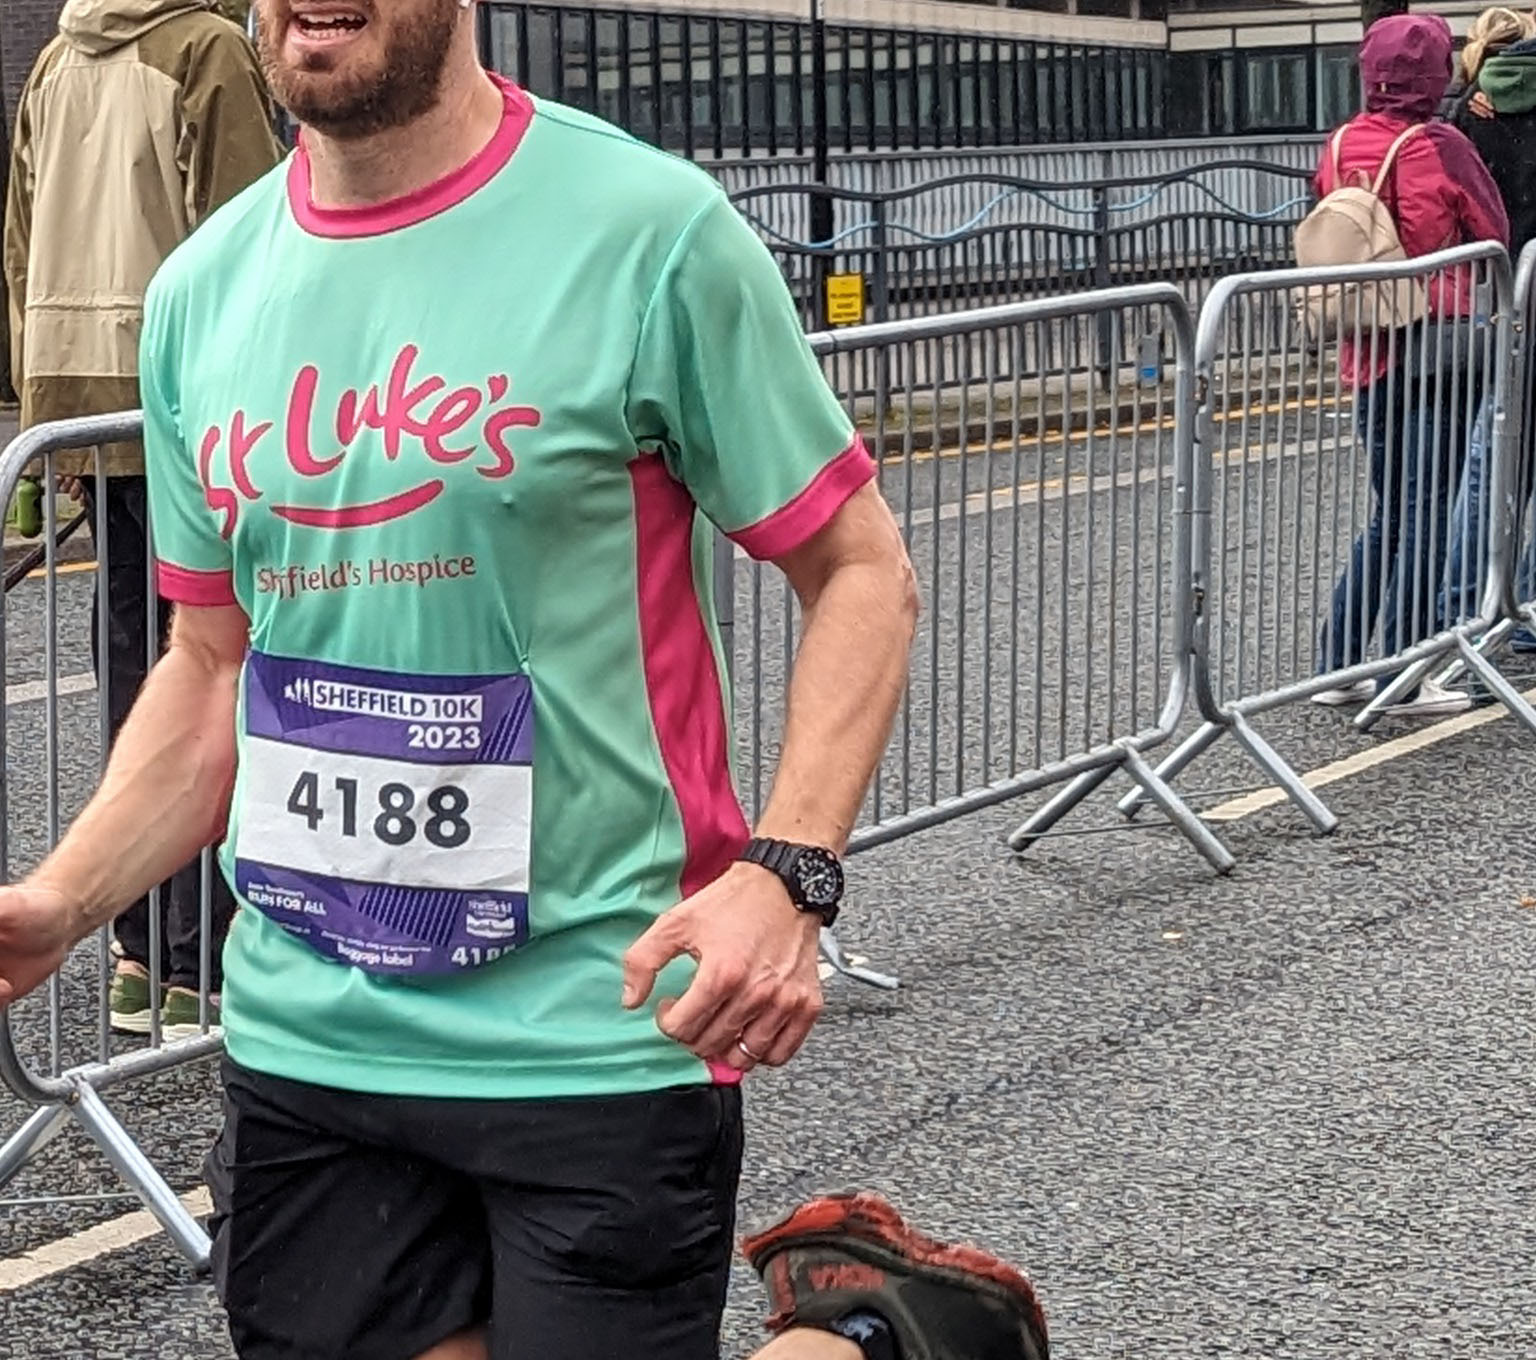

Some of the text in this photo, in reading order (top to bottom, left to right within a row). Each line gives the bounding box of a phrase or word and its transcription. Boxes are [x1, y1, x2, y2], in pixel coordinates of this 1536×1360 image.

[286, 343, 541, 478] Luke's
[368, 554, 477, 589] Hospice
[315, 684, 479, 719] SHEFFIELD 10K
[408, 725, 481, 750] 2023
[286, 771, 472, 849] 4188
[381, 951, 414, 967] label
